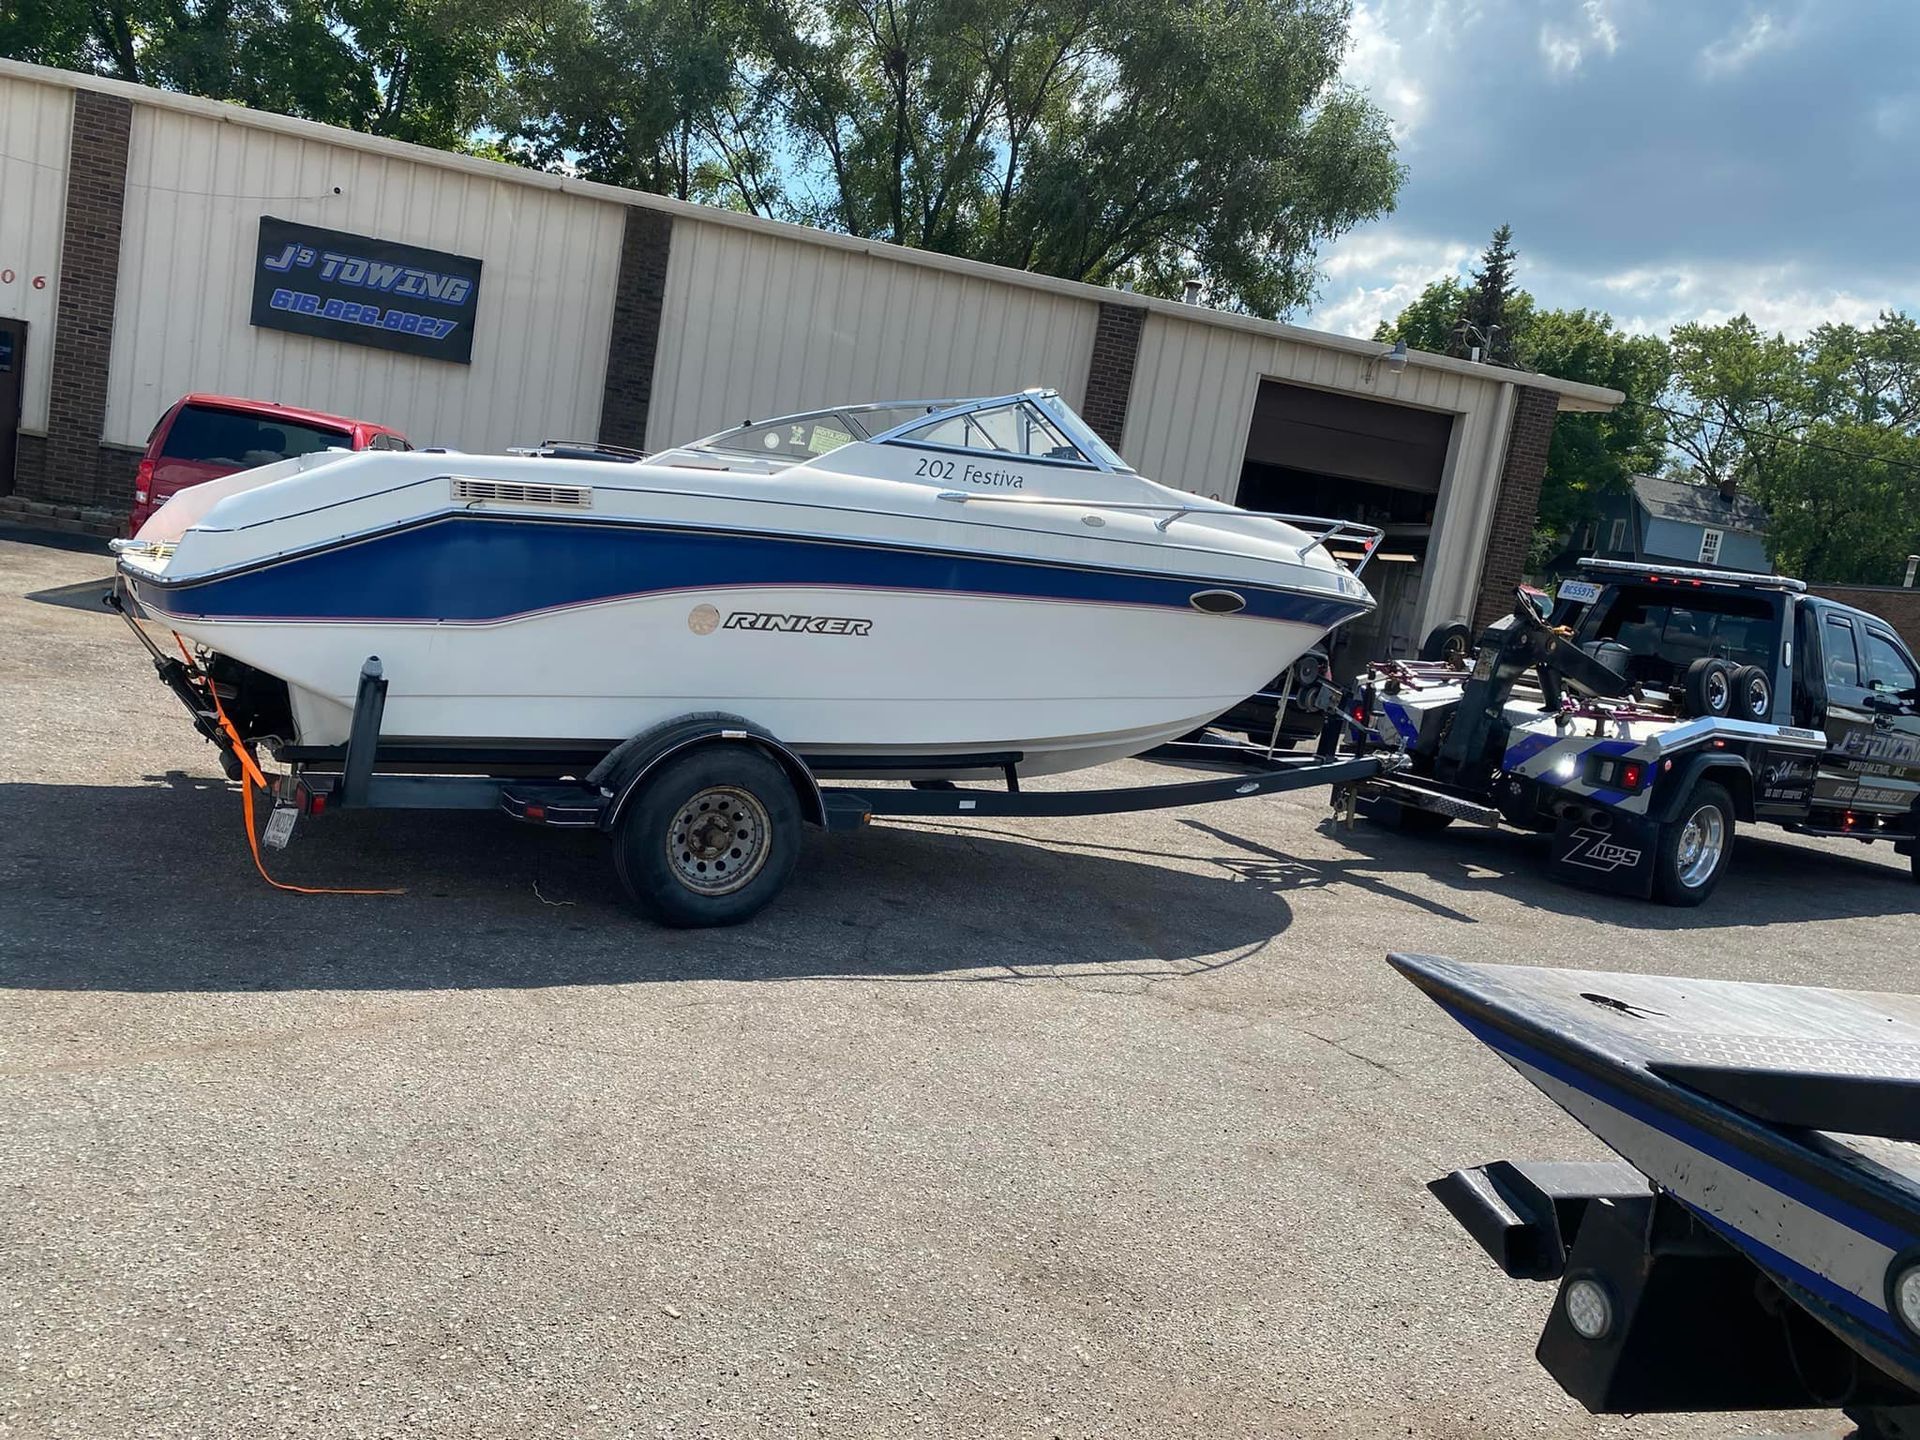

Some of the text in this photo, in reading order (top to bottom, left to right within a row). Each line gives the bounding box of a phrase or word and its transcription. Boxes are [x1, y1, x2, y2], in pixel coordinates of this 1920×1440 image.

[320, 252, 473, 305] TOWING
[270, 288, 458, 340] 616.826.8827
[914, 458, 1024, 489] 202 Festiva
[723, 612, 872, 636] RINKER
